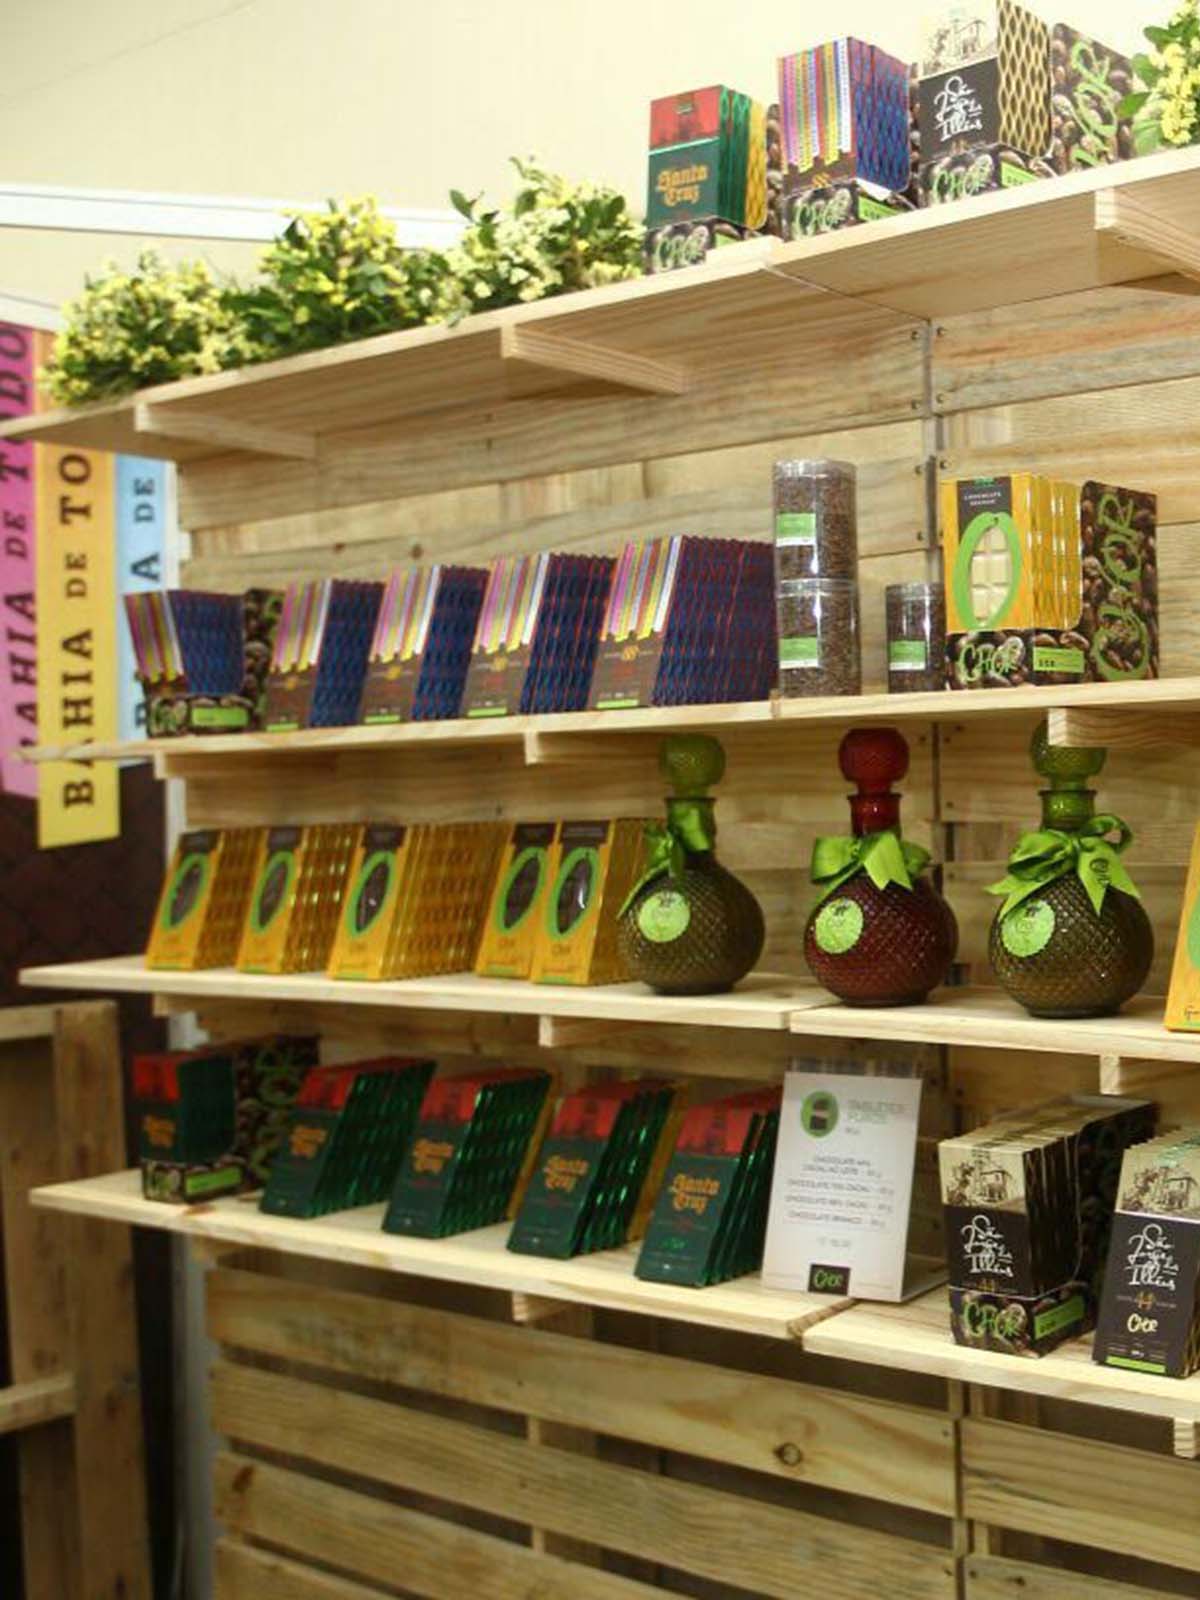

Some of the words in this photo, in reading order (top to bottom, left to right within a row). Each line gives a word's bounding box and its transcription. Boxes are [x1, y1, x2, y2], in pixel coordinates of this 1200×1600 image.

[133, 477, 156, 524] DE
[4, 511, 28, 559] DE
[65, 553, 88, 598] DE
